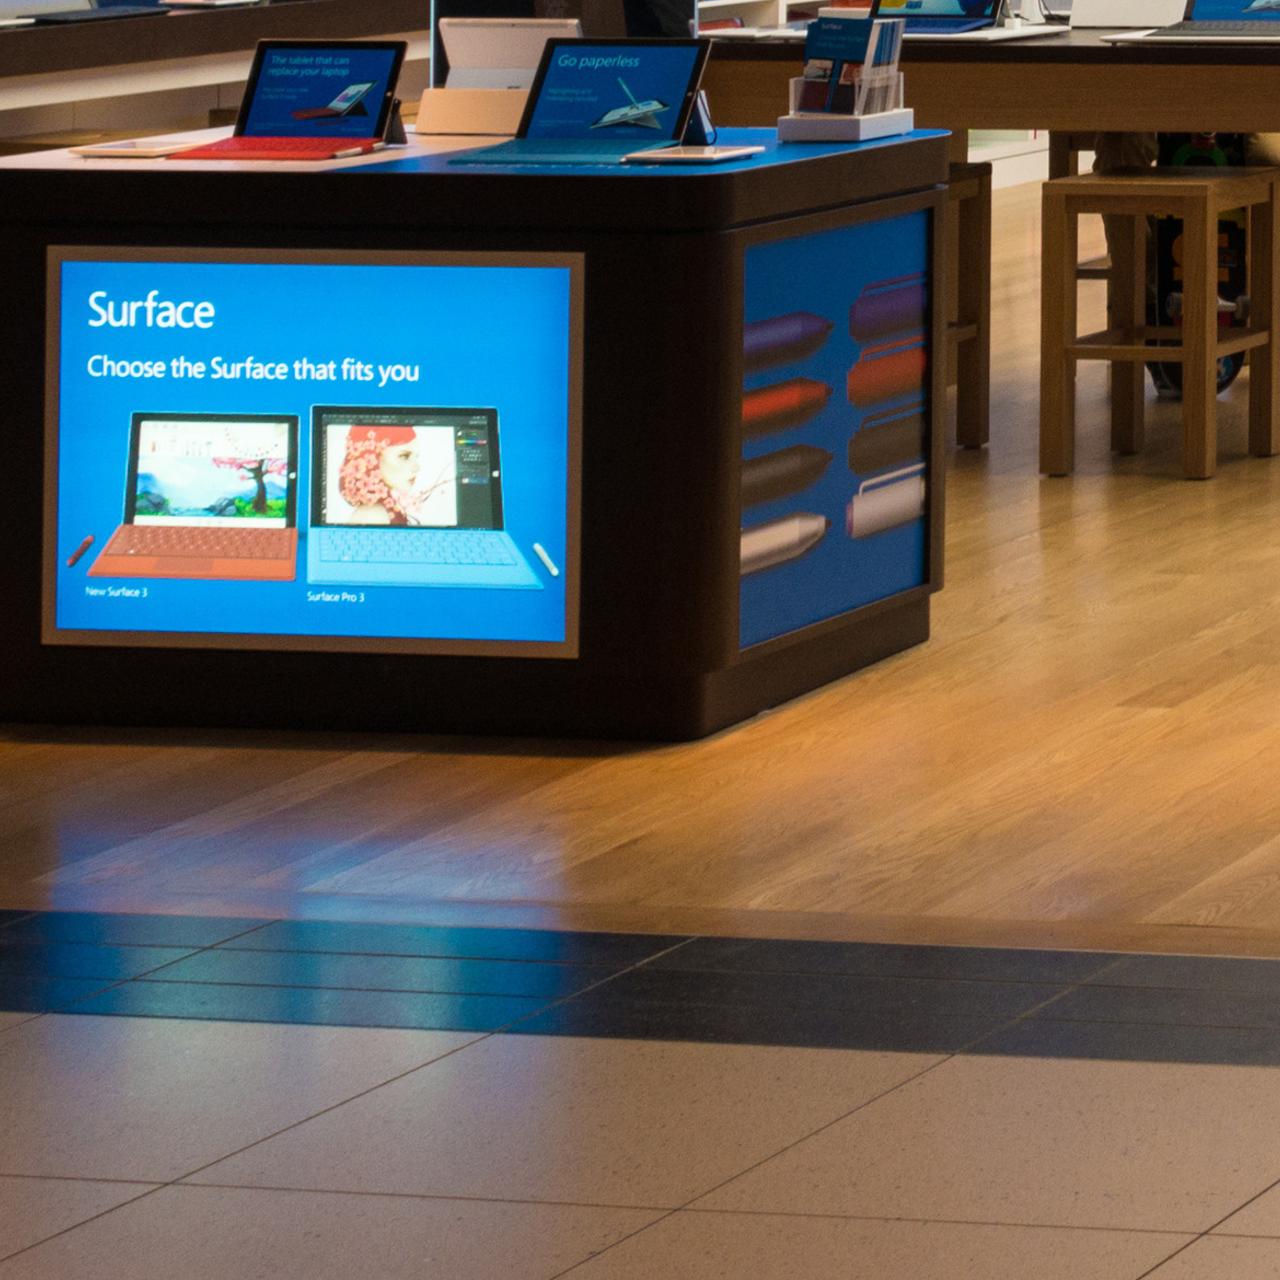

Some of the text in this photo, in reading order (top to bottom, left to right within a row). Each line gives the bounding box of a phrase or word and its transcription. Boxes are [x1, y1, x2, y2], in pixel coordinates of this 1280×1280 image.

[272, 55, 350, 65] The tablet that can
[558, 54, 640, 70] Go paperless
[268, 67, 350, 77] replace your laptop
[88, 290, 216, 329] Surface
[87, 354, 420, 388] Choose the Surface that fits you
[85, 586, 148, 598] New Surface 3
[307, 591, 365, 603] Surface Pro 3
